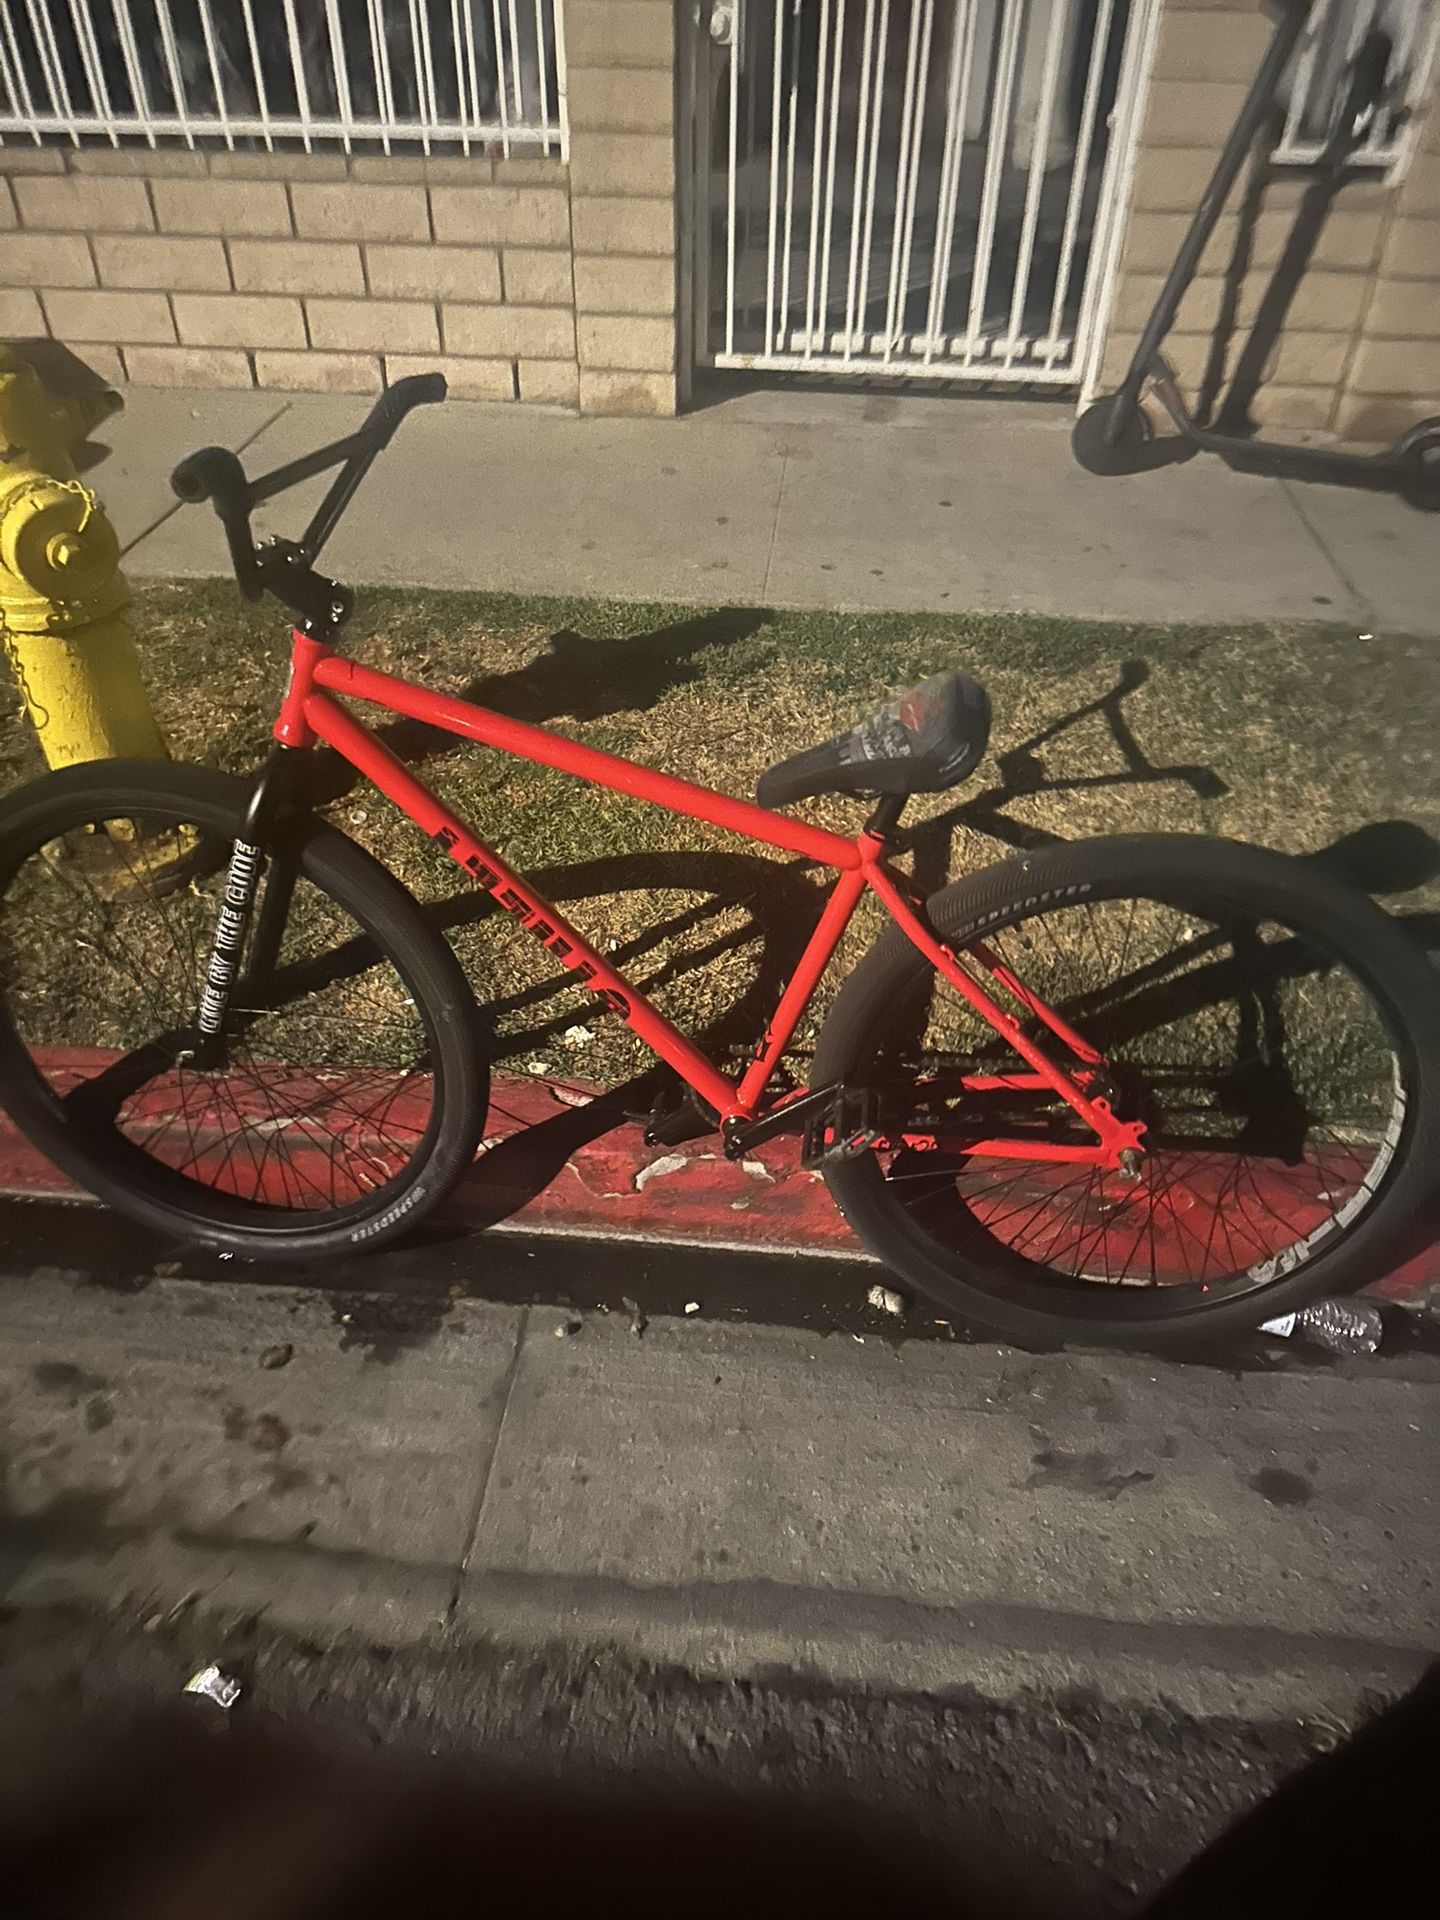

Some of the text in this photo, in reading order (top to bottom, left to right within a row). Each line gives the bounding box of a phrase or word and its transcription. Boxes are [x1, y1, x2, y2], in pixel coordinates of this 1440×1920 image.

[977, 883, 1092, 927] SPEEDSTER
[199, 838, 258, 1034] LIVE BY THE CODE
[351, 1197, 413, 1242] SPEEDSTER
